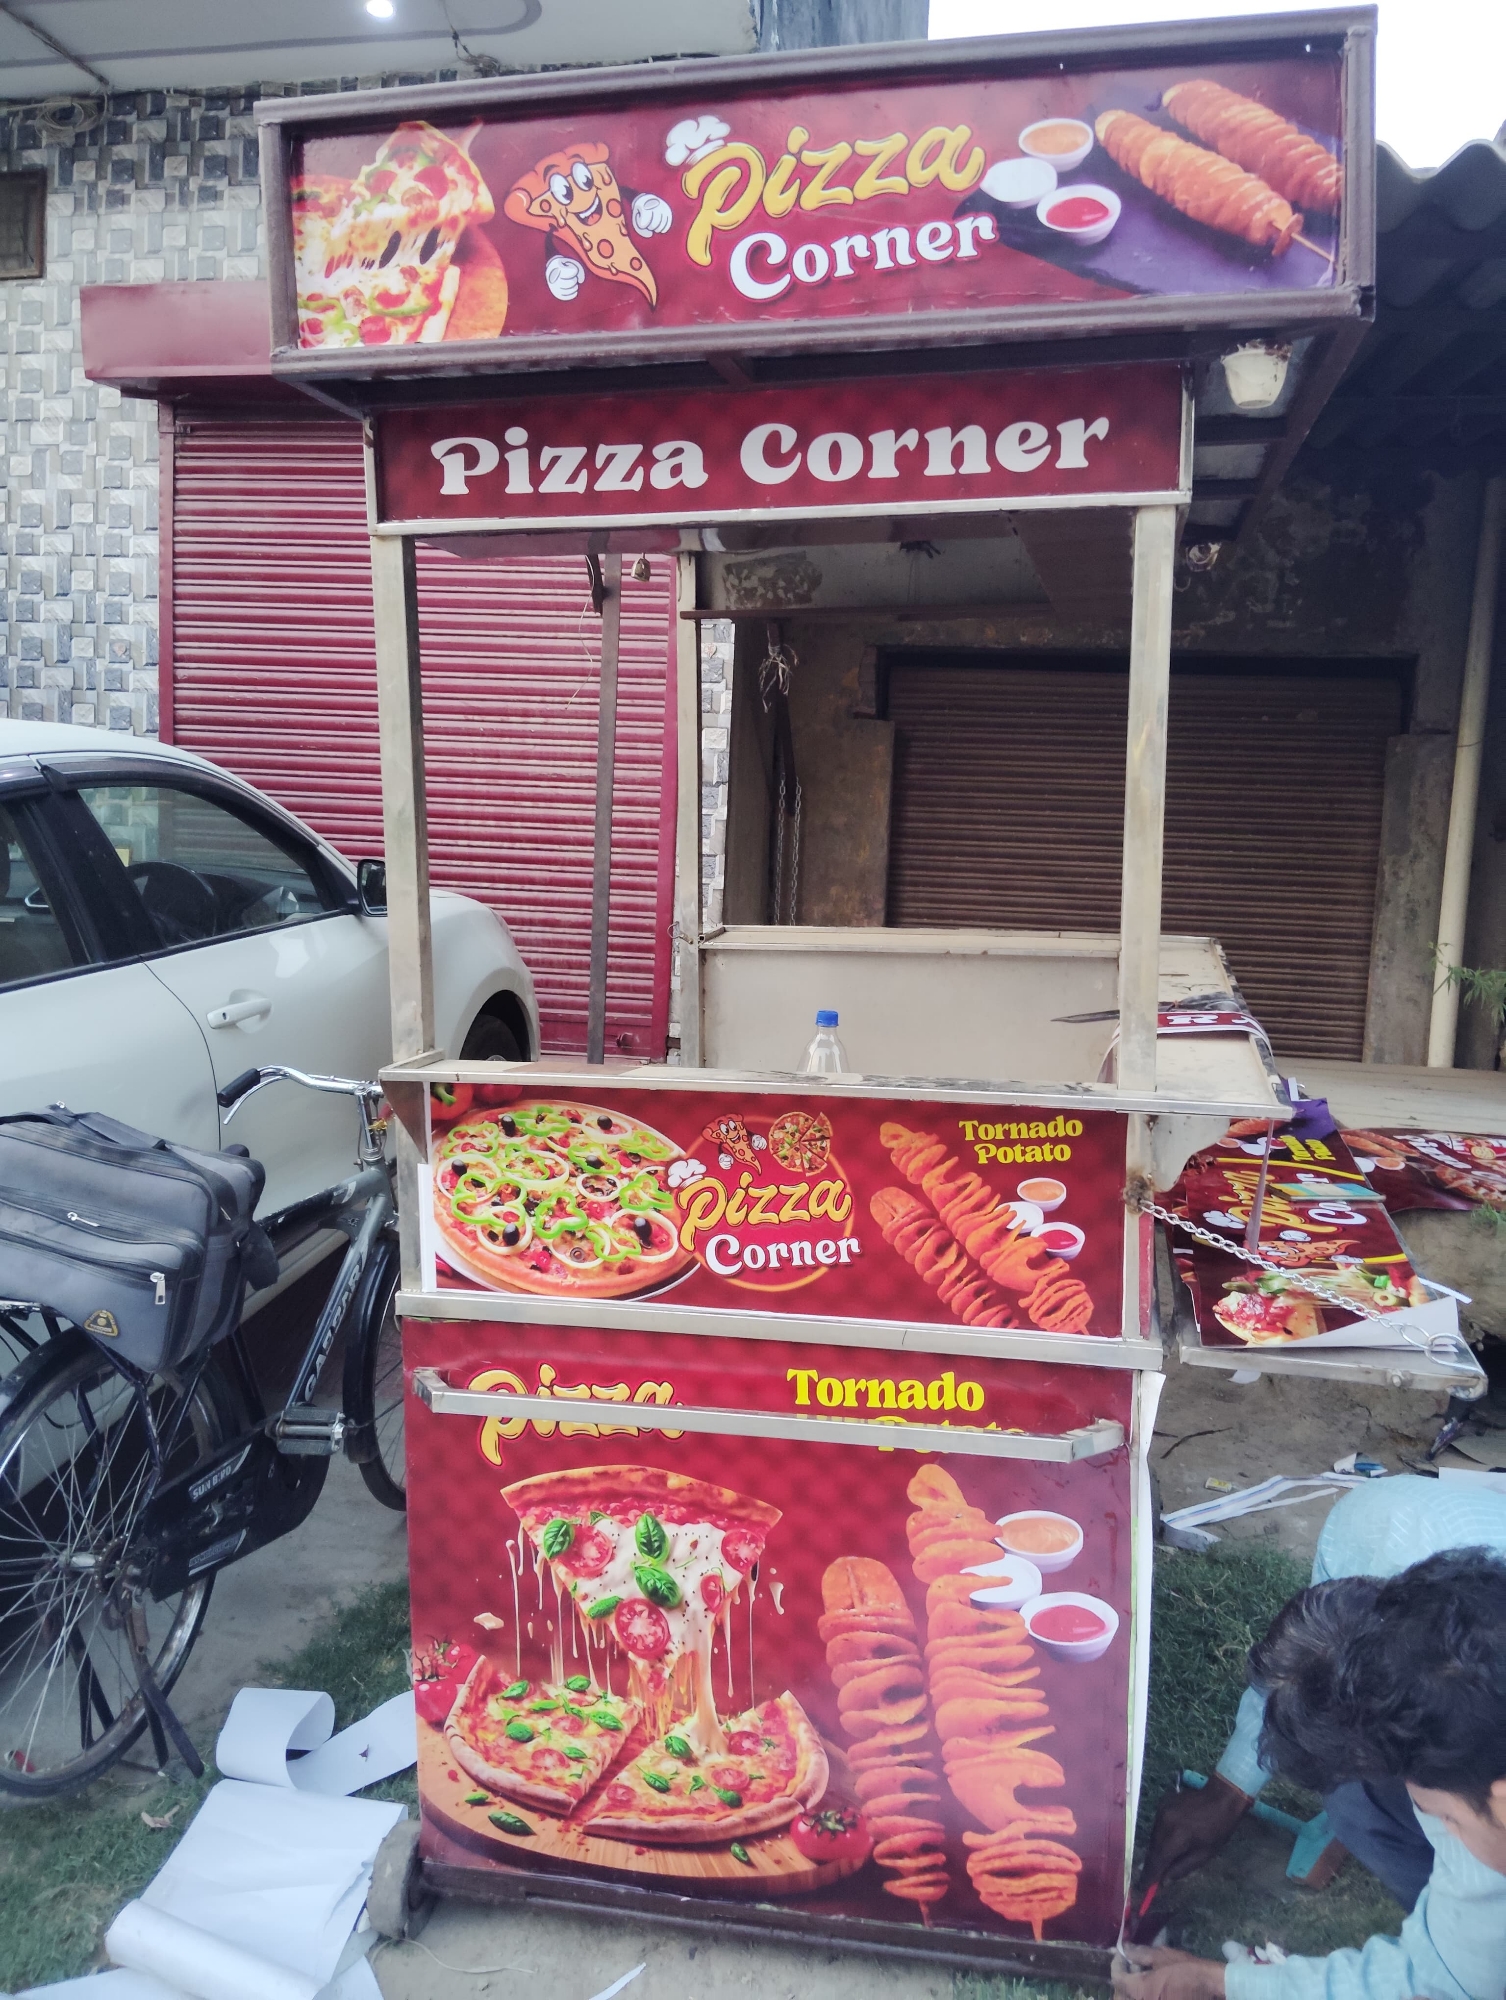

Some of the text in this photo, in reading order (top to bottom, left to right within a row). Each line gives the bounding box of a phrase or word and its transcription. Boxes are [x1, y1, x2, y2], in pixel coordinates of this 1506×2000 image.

[681, 124, 987, 267] Pizza
[729, 216, 996, 301] Corner
[430, 416, 1110, 496] Pizza Corner
[958, 1115, 1083, 1141] Tornado
[973, 1142, 1072, 1165] Potato
[678, 1171, 852, 1252] Pizza
[705, 1234, 861, 1275] Corner
[786, 1367, 985, 1411] Tornado
